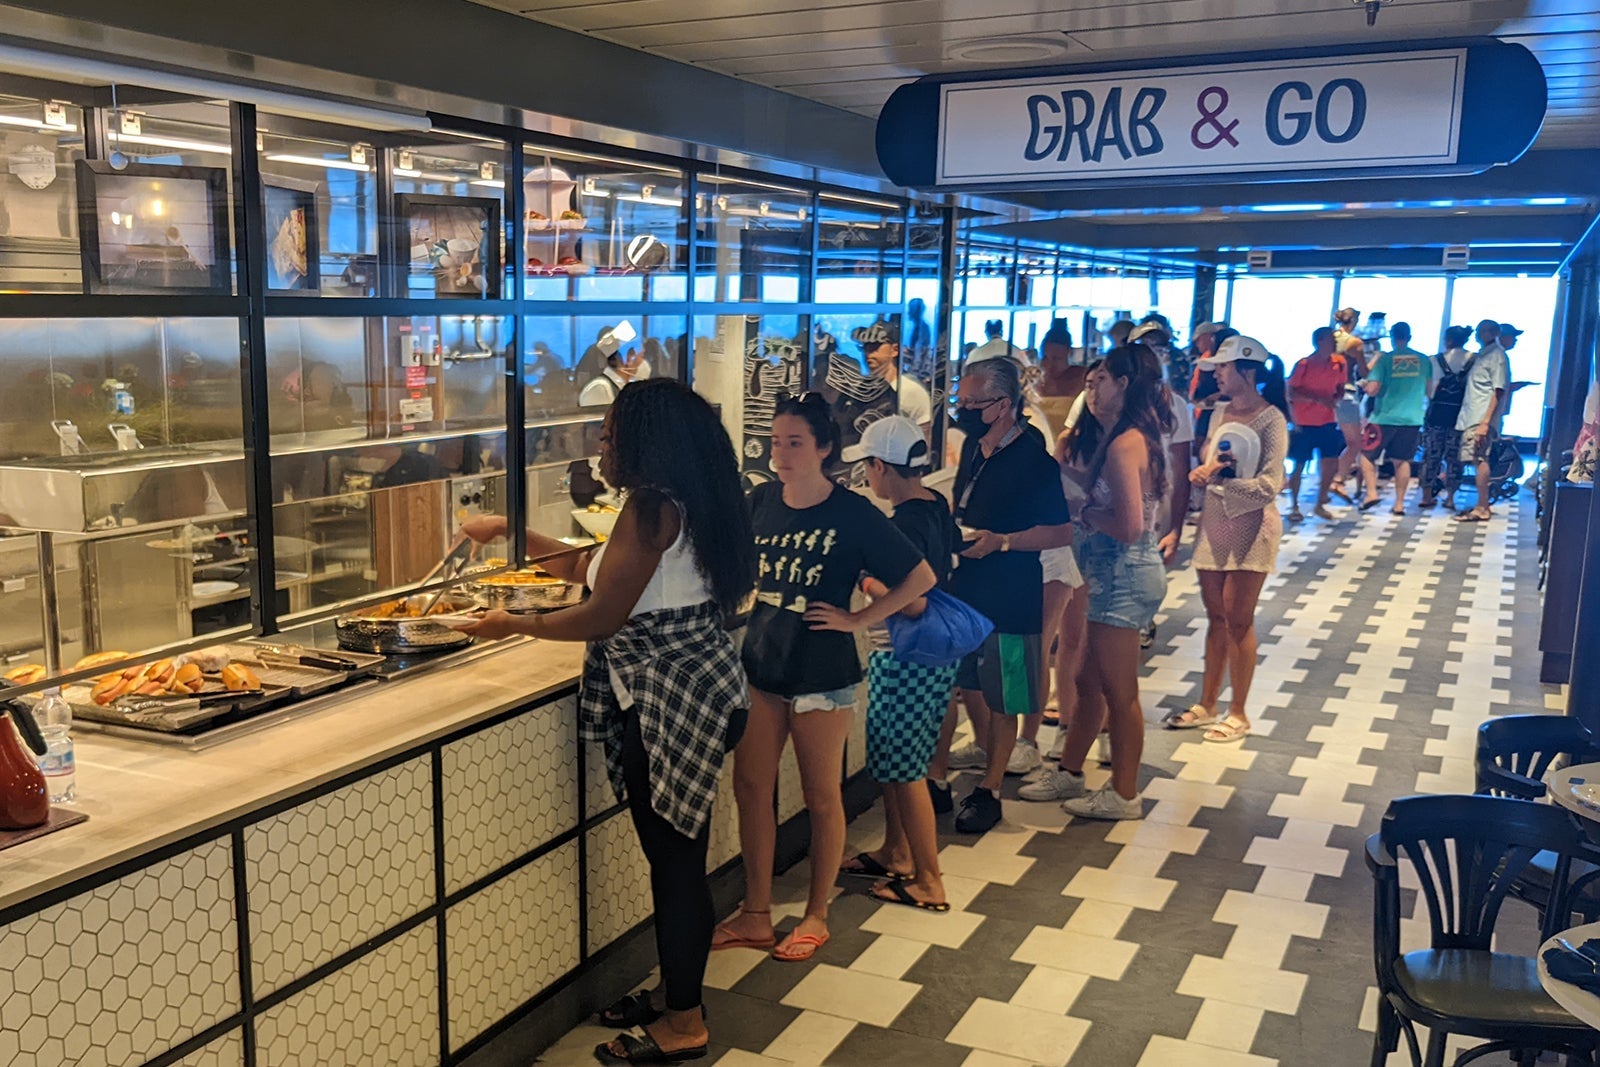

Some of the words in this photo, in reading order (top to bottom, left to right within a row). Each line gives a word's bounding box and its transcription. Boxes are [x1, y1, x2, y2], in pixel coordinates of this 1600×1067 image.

[1024, 87, 1167, 162] GRAB
[1190, 86, 1240, 149] &
[1264, 78, 1367, 147] GO
